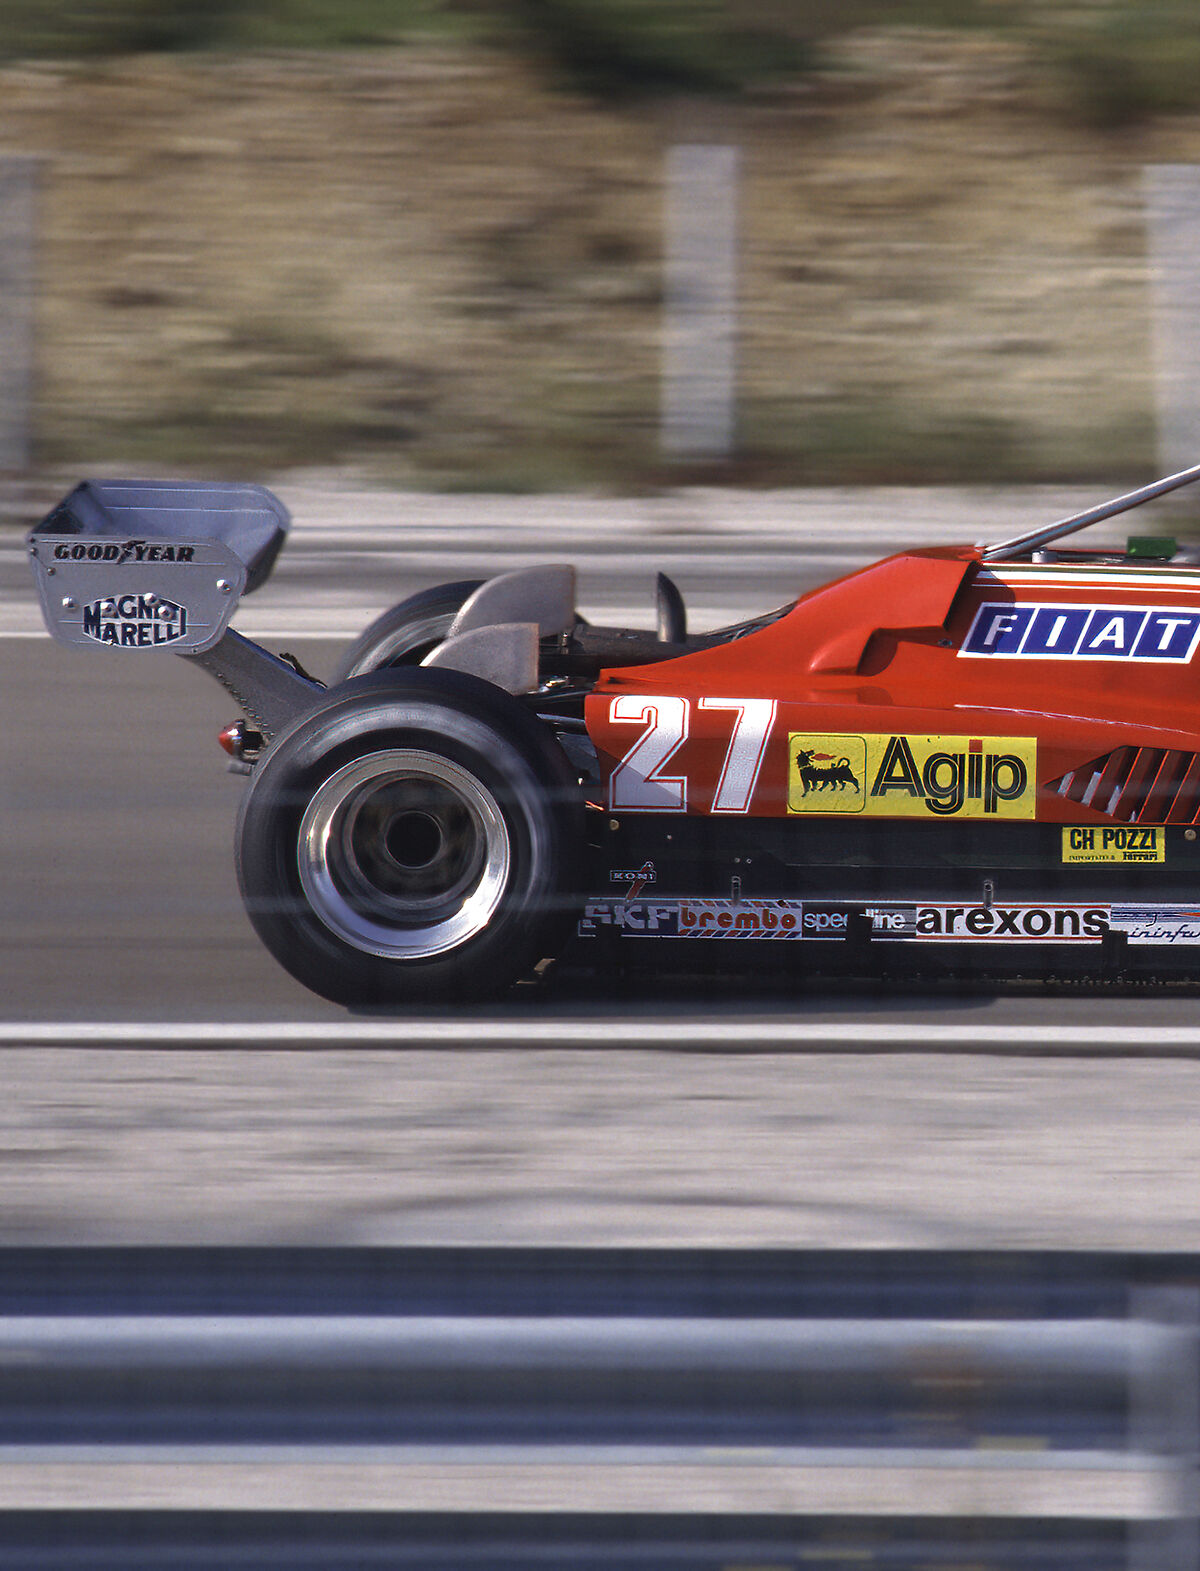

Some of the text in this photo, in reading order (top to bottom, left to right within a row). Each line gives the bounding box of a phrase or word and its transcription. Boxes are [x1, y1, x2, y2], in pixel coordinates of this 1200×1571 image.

[54, 541, 194, 562] GOODYEAR
[984, 614, 1191, 650] FIAT
[609, 695, 777, 813] 27
[870, 735, 1028, 815] Agip
[1070, 828, 1157, 850] CH POZZI
[613, 872, 653, 880] KONI
[680, 906, 798, 930] brembo
[917, 908, 1110, 937] arexons
